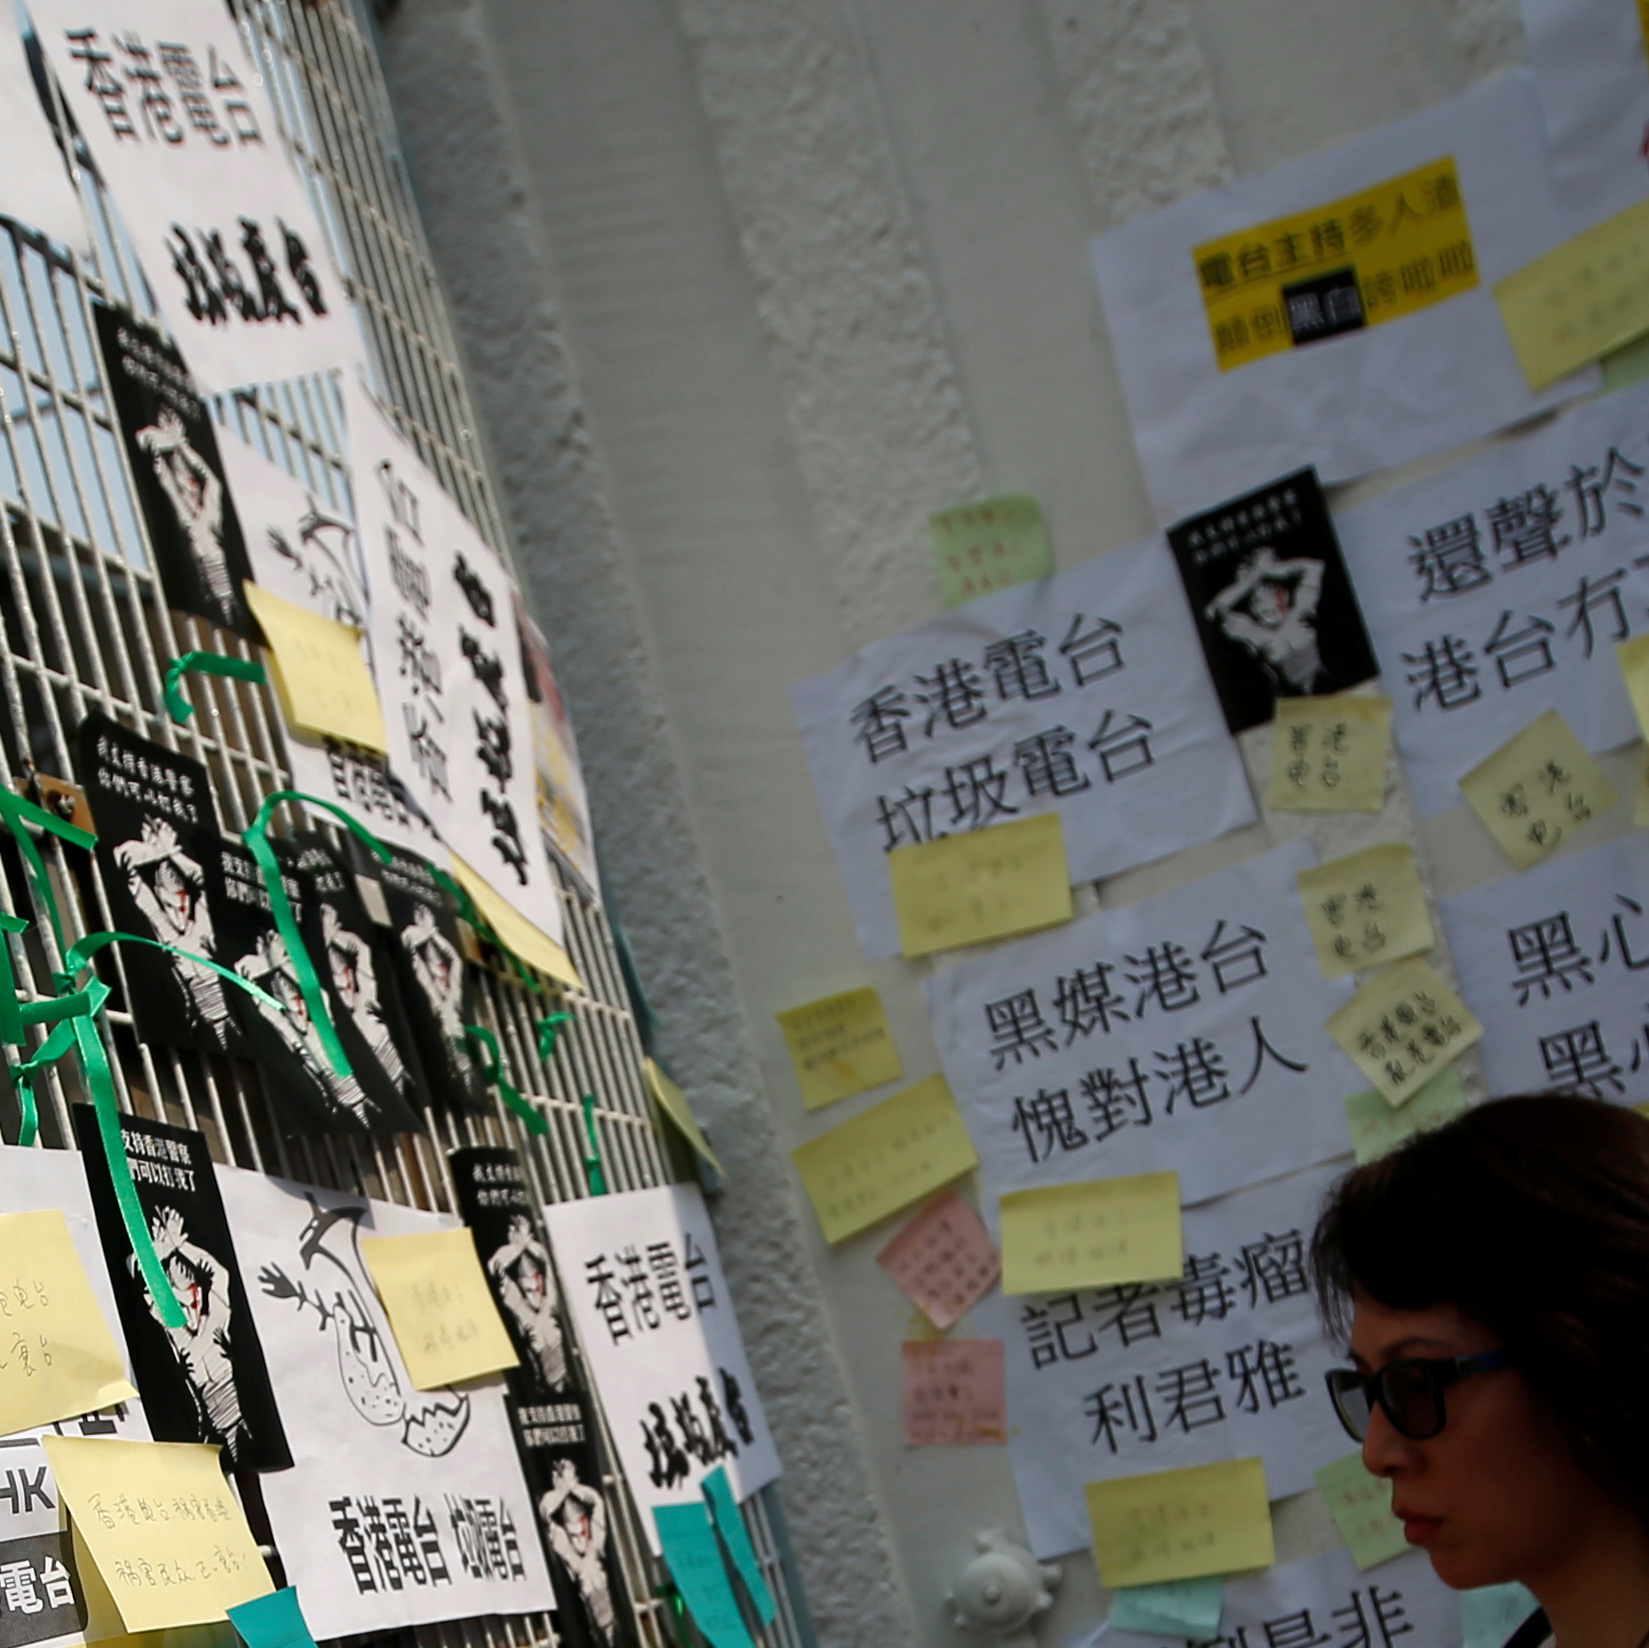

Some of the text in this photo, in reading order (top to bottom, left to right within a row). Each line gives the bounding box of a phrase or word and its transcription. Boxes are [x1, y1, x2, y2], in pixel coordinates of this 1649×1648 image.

[65, 27, 262, 147] 香港電台
[851, 612, 1125, 765] 香港電台
[876, 709, 1154, 855] 垃圾電台
[984, 920, 1268, 1072] 黑媒港台
[120, 1129, 191, 1164] 支持香港警察
[1011, 1015, 1310, 1165] 愧對港人
[126, 1157, 196, 1191] 們可以打我了
[584, 1233, 716, 1346] 香港電台
[1019, 1227, 1310, 1370] 記者毒瘤
[1084, 1336, 1306, 1455] 利君雅
[327, 1493, 450, 1597] 香港電台
